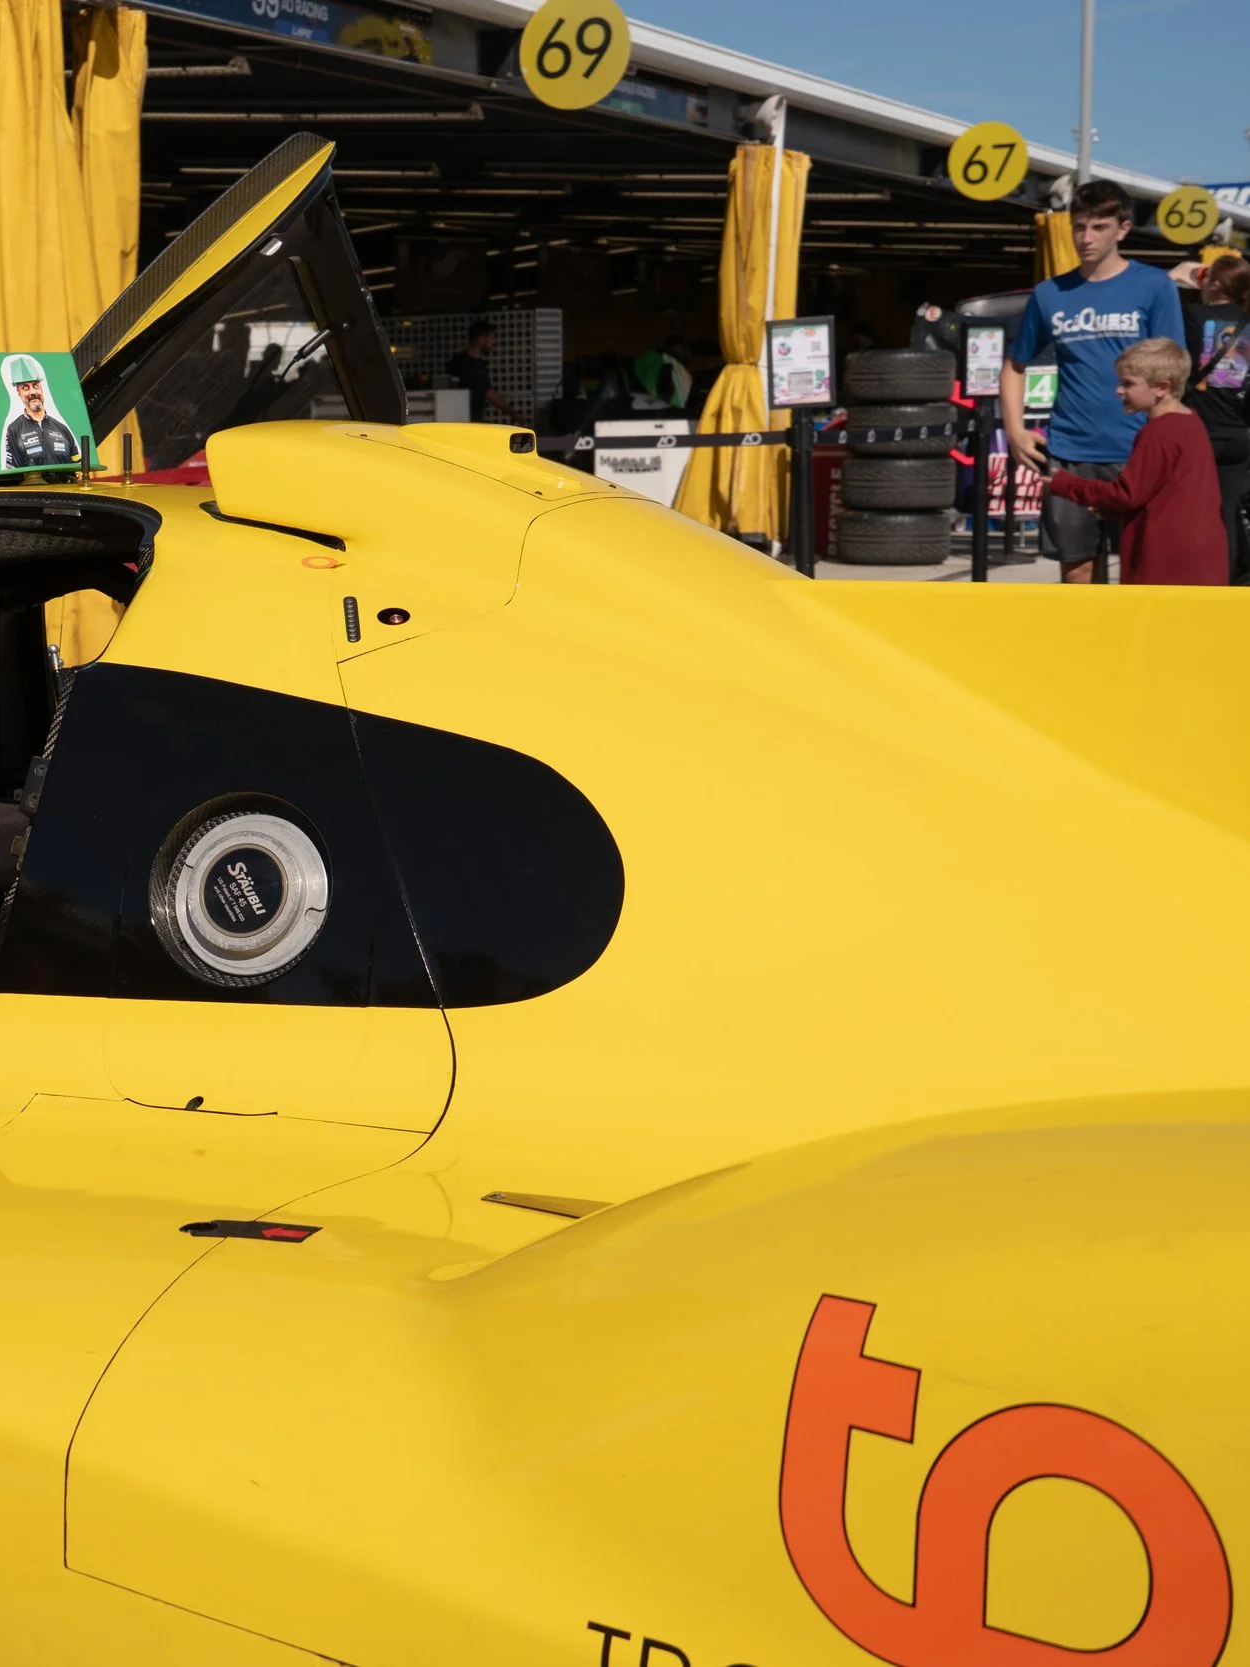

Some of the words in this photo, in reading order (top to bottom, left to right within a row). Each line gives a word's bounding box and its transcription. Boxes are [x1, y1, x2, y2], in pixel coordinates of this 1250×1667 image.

[295, 0, 329, 22] RACING
[536, 17, 613, 80] 69
[961, 142, 1017, 186] 67
[1164, 198, 1209, 230] 65
[1051, 307, 1141, 336] SciQuest
[229, 882, 242, 896] SAF
[238, 897, 248, 907] 45
